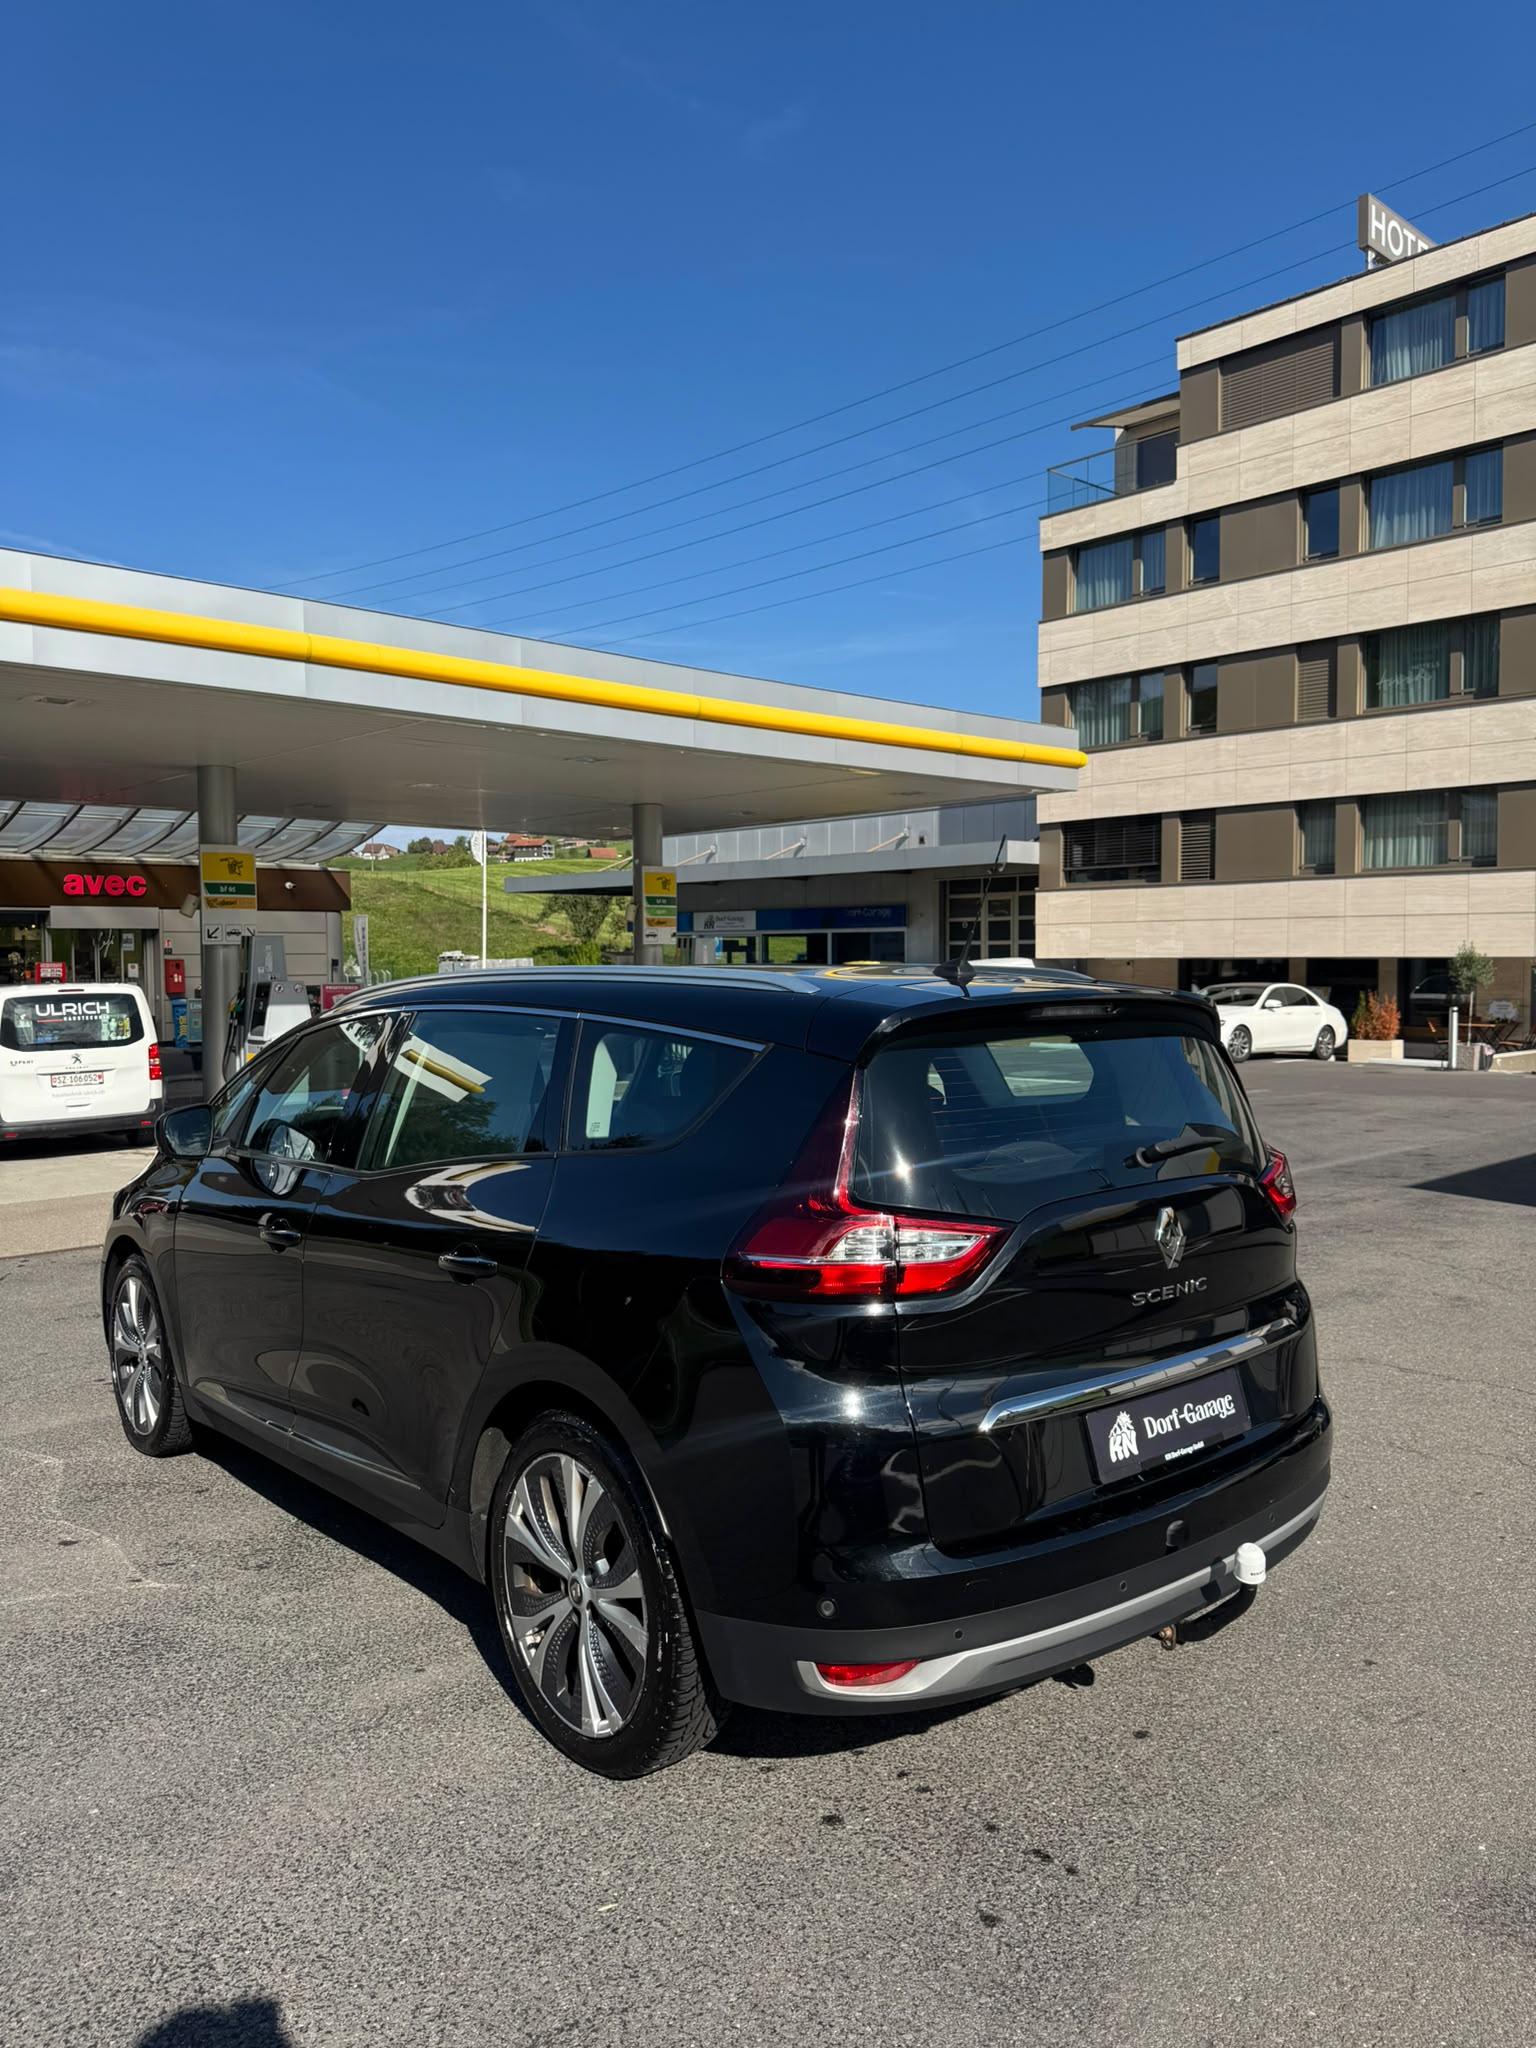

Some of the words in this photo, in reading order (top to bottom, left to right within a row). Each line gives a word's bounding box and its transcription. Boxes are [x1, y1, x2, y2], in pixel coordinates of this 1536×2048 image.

[63, 874, 147, 897] avec
[35, 1001, 110, 1016] ULRICH
[1131, 1277, 1207, 1307] SCENIC
[1143, 1394, 1235, 1439] Dorf-Garage
